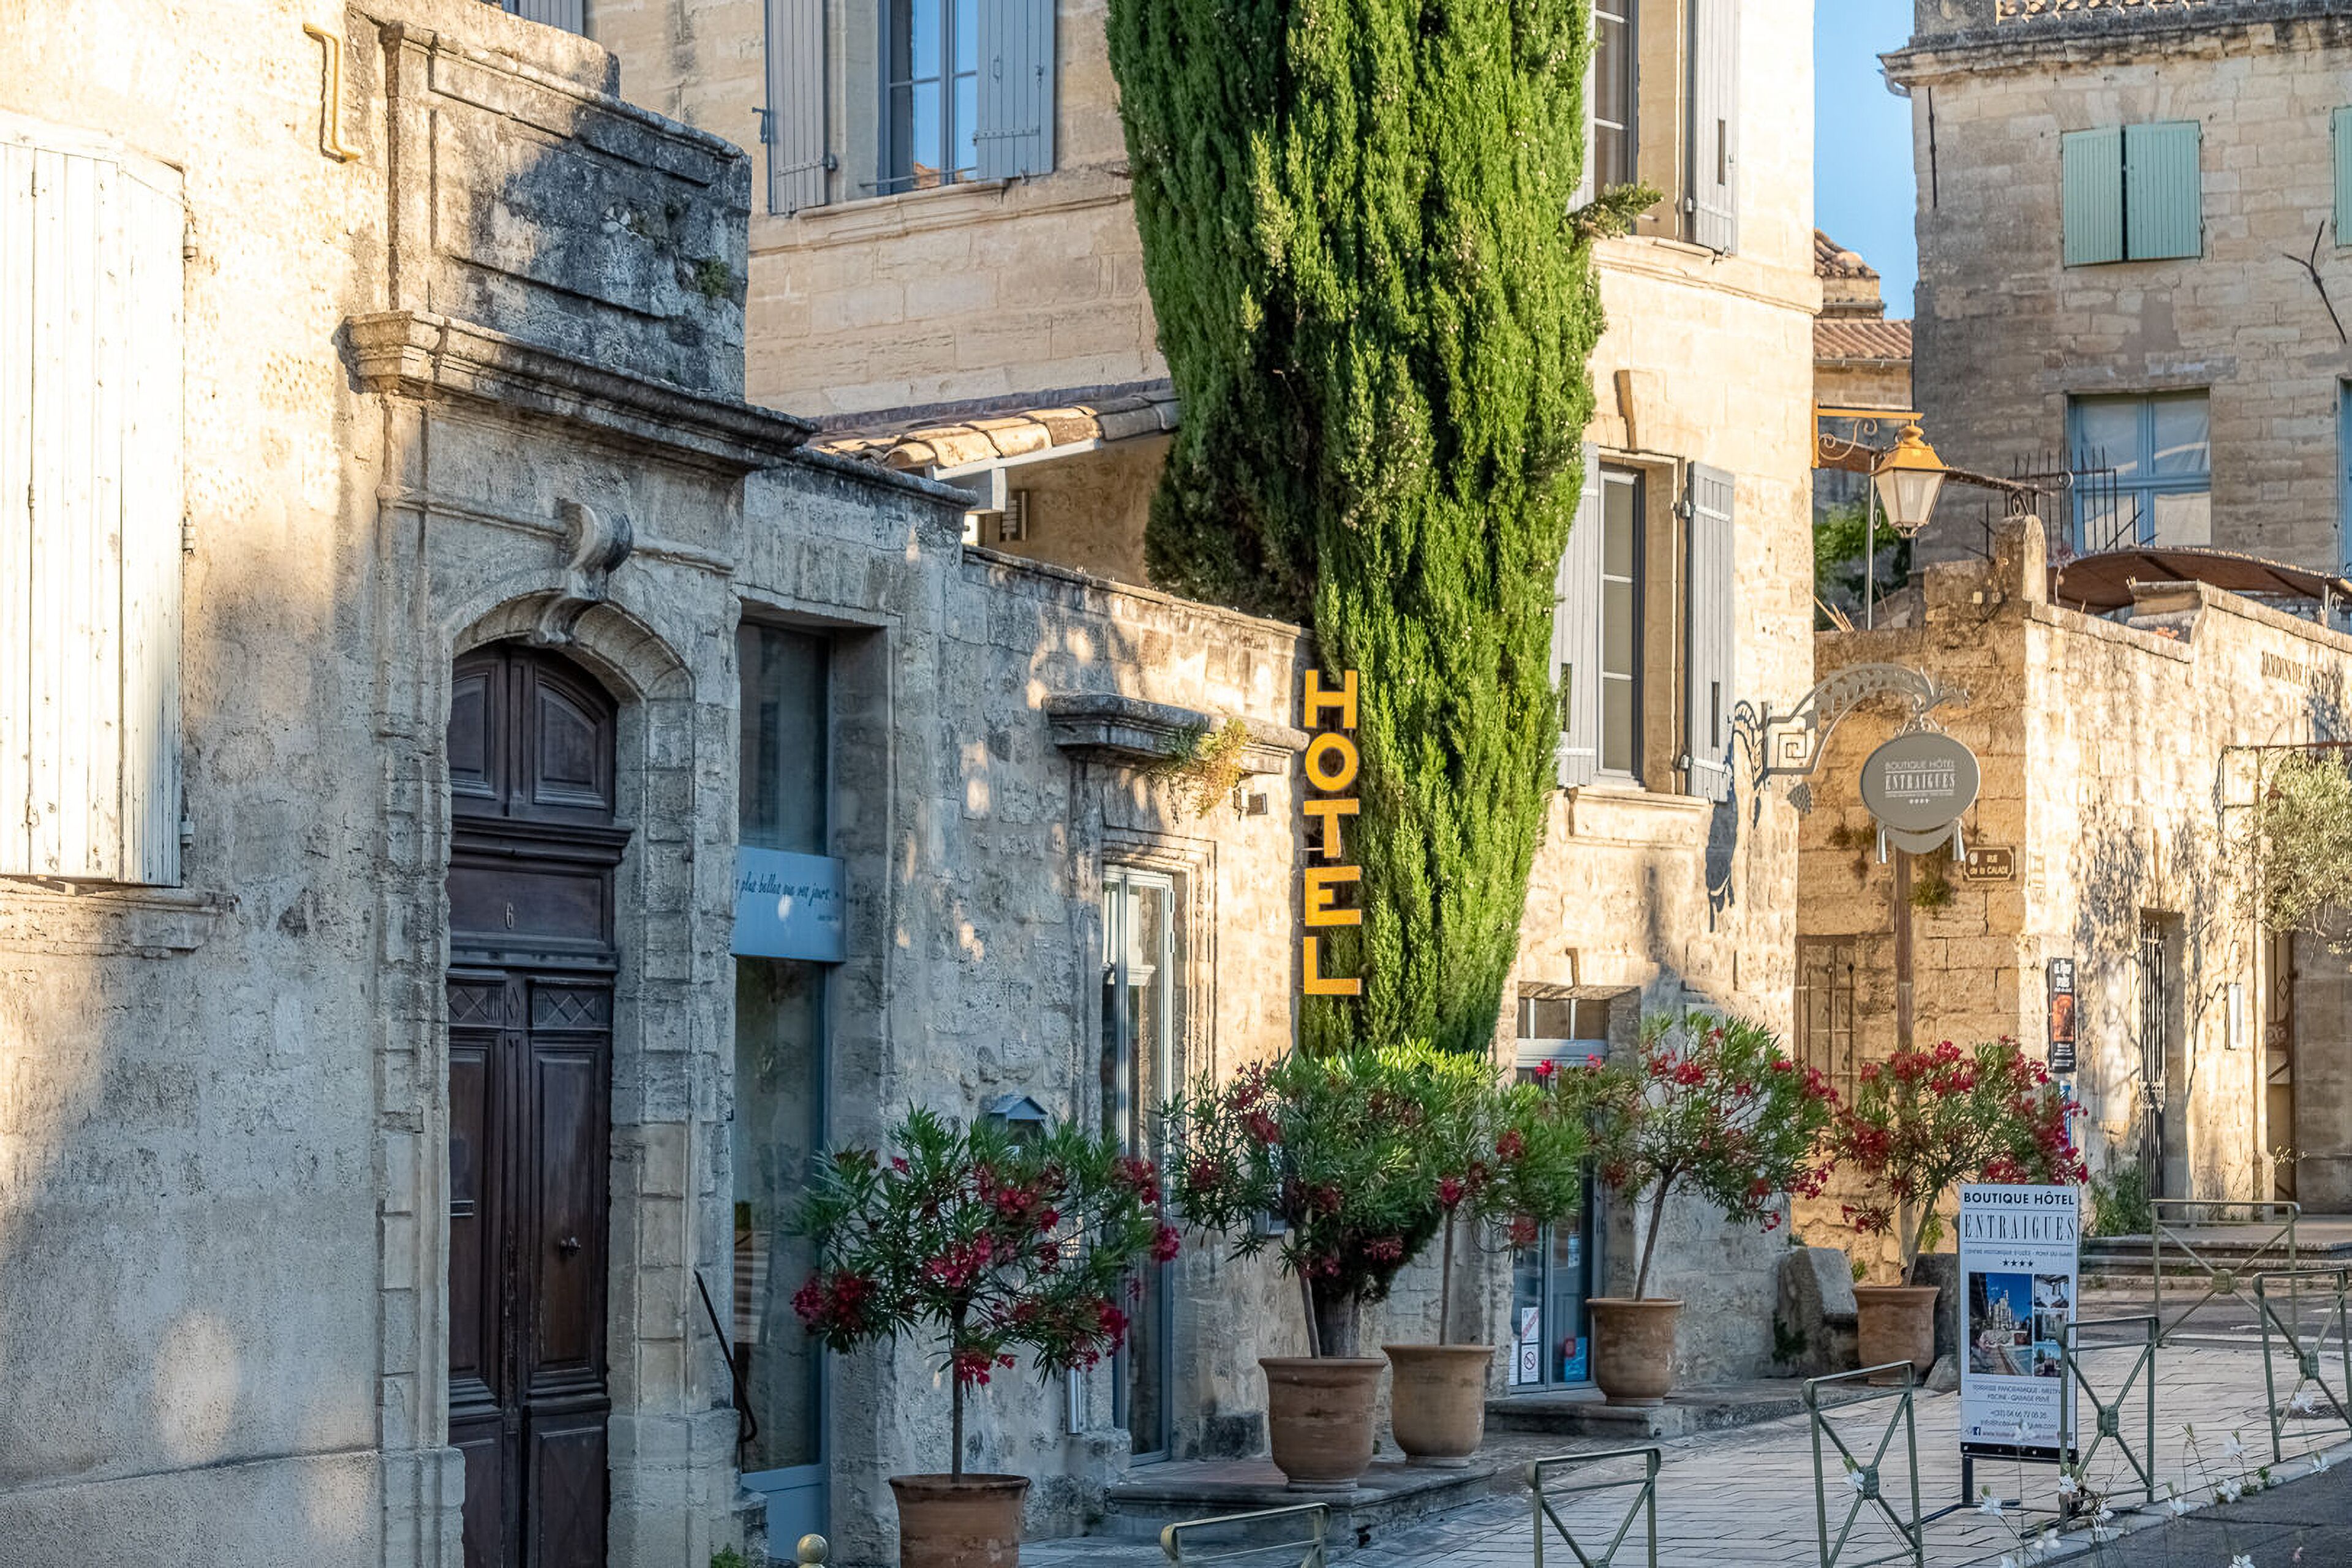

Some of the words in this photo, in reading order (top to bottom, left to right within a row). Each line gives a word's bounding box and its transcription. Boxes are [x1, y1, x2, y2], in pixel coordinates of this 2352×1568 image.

[1303, 669, 1362, 995] HOTEL
[506, 902, 514, 930] 6
[1964, 1193, 2029, 1204] BOUTIQUE
[2034, 1191, 2075, 1205] HÔTEL
[1964, 1213, 2075, 1242] ENTRAIGUES
